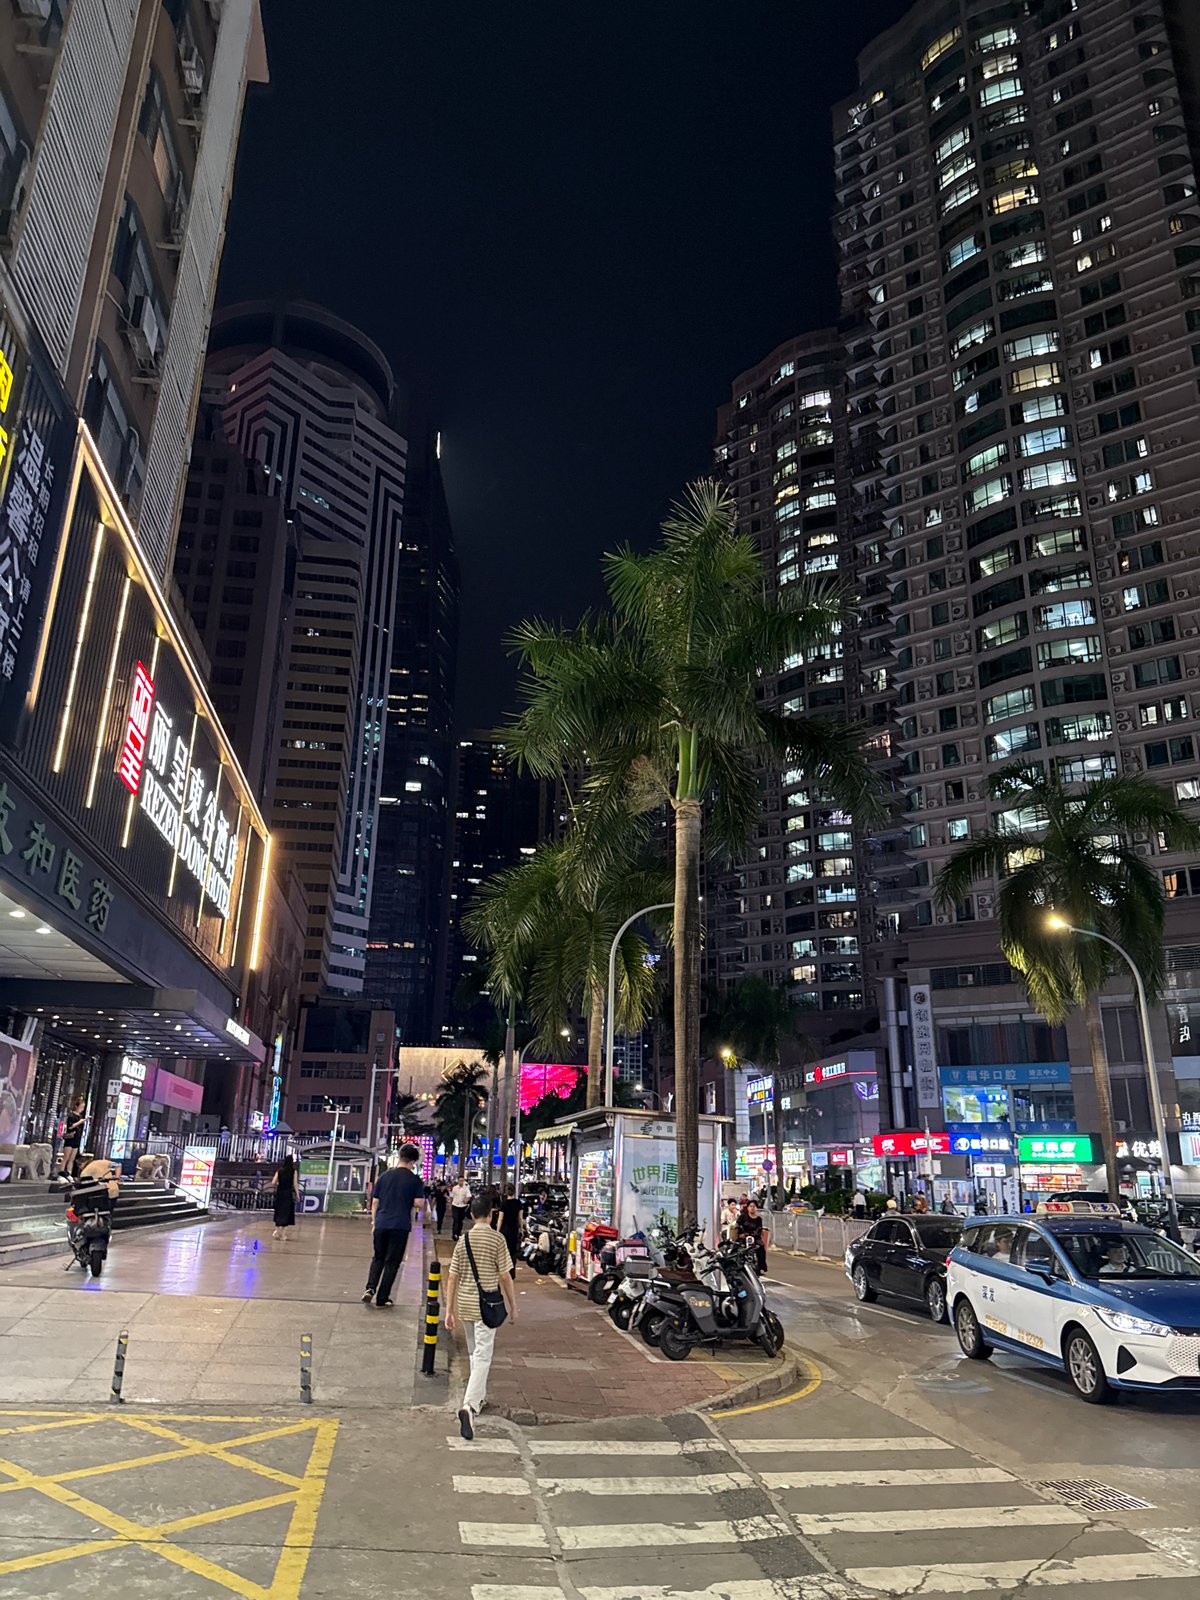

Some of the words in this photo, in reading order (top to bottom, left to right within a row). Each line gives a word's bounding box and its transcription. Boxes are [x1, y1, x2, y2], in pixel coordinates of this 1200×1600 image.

[27, 456, 55, 568] 长期招租
[140, 769, 183, 851] REZEN
[632, 1162, 704, 1189] 世界清日
[302, 1195, 320, 1213] P
